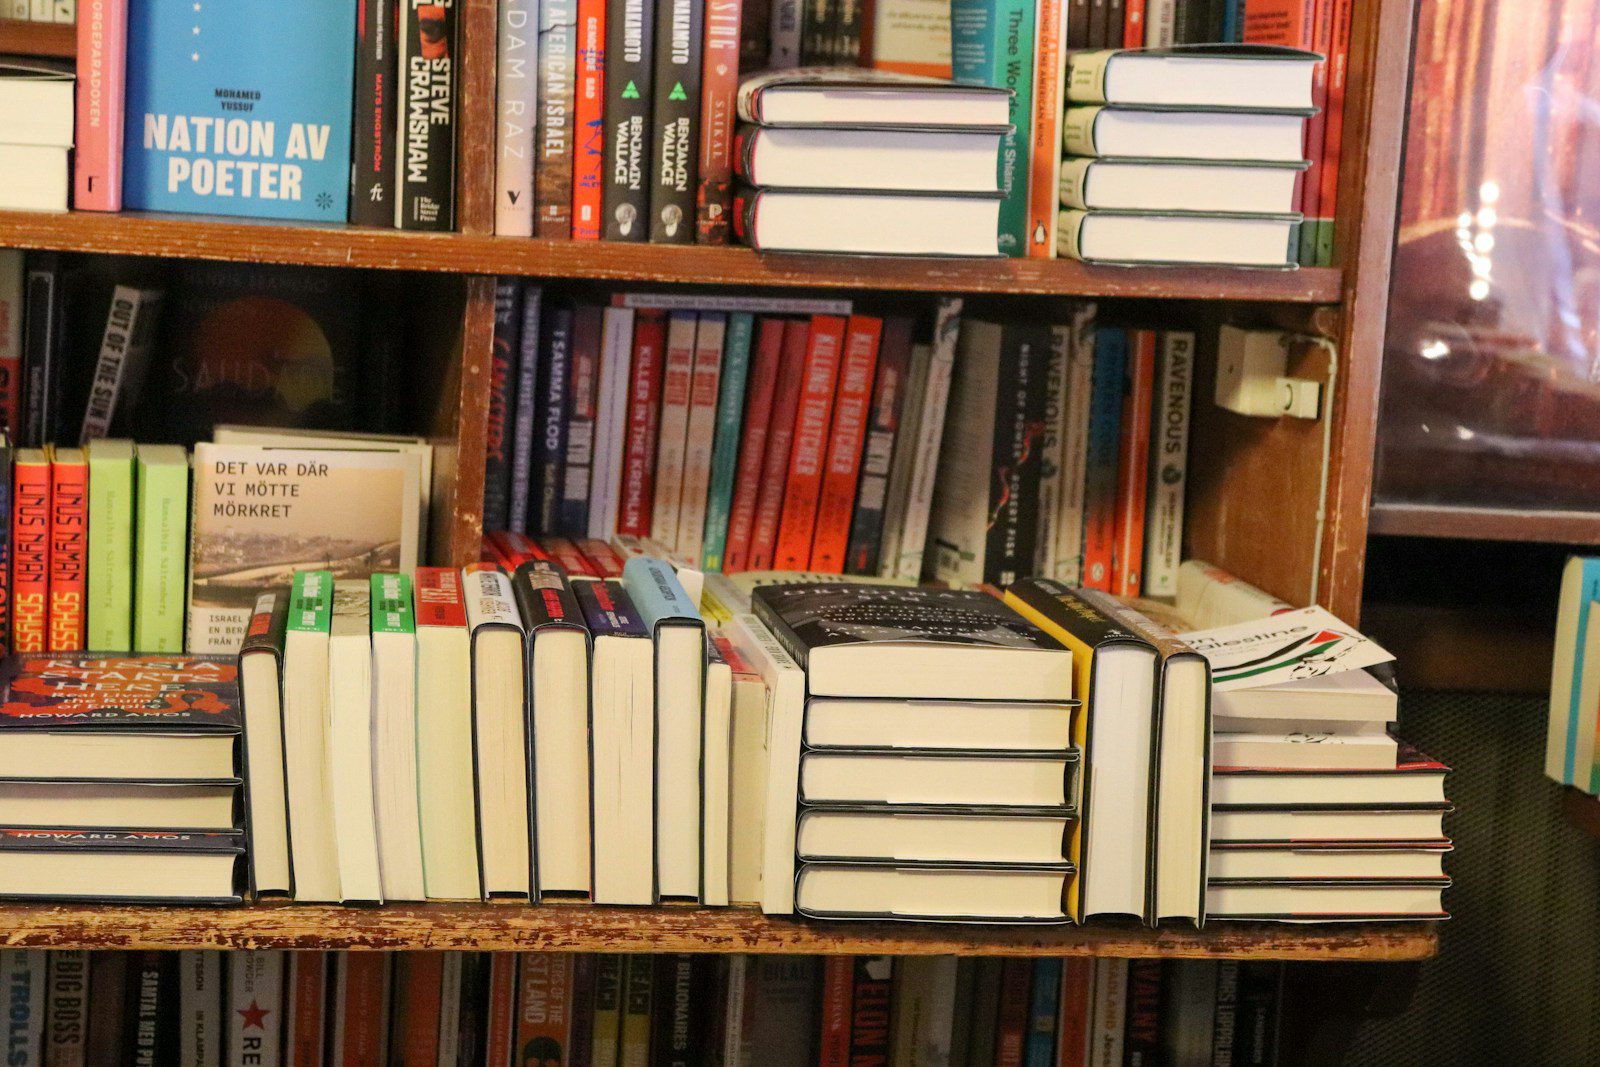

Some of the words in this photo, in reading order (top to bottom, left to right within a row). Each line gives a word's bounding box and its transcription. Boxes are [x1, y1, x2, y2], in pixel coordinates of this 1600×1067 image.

[547, 7, 567, 93] AMERICAN
[1008, 8, 1024, 55] Three
[1040, 51, 1048, 67] THE
[214, 88, 261, 100] MOHAMED
[220, 101, 254, 112] YUSSUF
[374, 73, 383, 105] MATS
[430, 58, 451, 125] STEVE
[1038, 70, 1047, 119] AMERICAN
[143, 113, 275, 157] NATION
[285, 123, 331, 161] AV
[372, 107, 382, 172] ENGSTRÖM
[407, 56, 431, 182] CRAWSHAW
[504, 99, 525, 159] RAZ
[545, 99, 565, 158] ISRAEL
[711, 100, 727, 160] SAIKAL
[1036, 121, 1044, 148] MIND
[614, 121, 630, 184] WALLACE
[629, 115, 643, 190] BENJAMIN
[661, 122, 677, 186] WALLACE
[675, 117, 690, 192] BENJAMIN
[168, 157, 303, 201] POETER
[111, 300, 134, 331] OUT
[105, 332, 126, 353] OF
[807, 332, 838, 393] KILLING
[843, 332, 875, 394] KILLING
[1018, 344, 1031, 385] NIGHT
[97, 357, 120, 385] THE
[547, 340, 567, 402] SAMMA
[634, 345, 652, 400] KILLER
[633, 404, 647, 420] IN
[1016, 390, 1027, 407] OF
[1164, 340, 1189, 454] RAVENOUS
[545, 406, 561, 450] FLOD
[631, 423, 647, 455] THE
[795, 398, 829, 476] THATCHER
[829, 397, 865, 475] THATCHER
[1011, 413, 1024, 459] POWER
[214, 482, 236, 496] VI
[245, 480, 300, 497] MÖTTE
[215, 460, 249, 475] DET
[256, 462, 288, 476] VAR
[297, 460, 329, 477] DÄR
[19, 483, 46, 526] LINUS
[56, 483, 82, 526] LINUS
[213, 501, 292, 518] MÖRKRET
[626, 460, 643, 528] KREMLIN
[1007, 474, 1020, 523] ROBERT
[17, 533, 44, 582] NYMAN
[55, 532, 81, 581] NYMAN
[1004, 528, 1017, 558] FISK
[15, 593, 44, 652] SCHYSS
[52, 591, 80, 651] SCHYSS
[208, 614, 243, 623] ISRAEL
[208, 626, 222, 634] EN
[208, 635, 233, 646] FRÅN
[1194, 626, 1308, 650] alestine
[38, 671, 220, 682] STARTS
[47, 660, 221, 671] RUSSIA
[55, 682, 186, 692] HERE
[16, 832, 117, 840] HOWARD
[56, 961, 83, 992] BIG
[255, 957, 264, 977] BILL
[139, 971, 159, 1017] SAMTAL
[195, 1010, 204, 1020] IN
[525, 980, 547, 1024] LAND
[549, 1005, 563, 1025] THE
[550, 987, 563, 999] OF
[673, 962, 690, 1050] BILLIONAIRES
[854, 982, 889, 1046] ELON
[8, 970, 31, 1067] TROLLS
[53, 997, 81, 1046] BOSS
[137, 1021, 156, 1046] MED
[136, 1049, 153, 1067] PU
